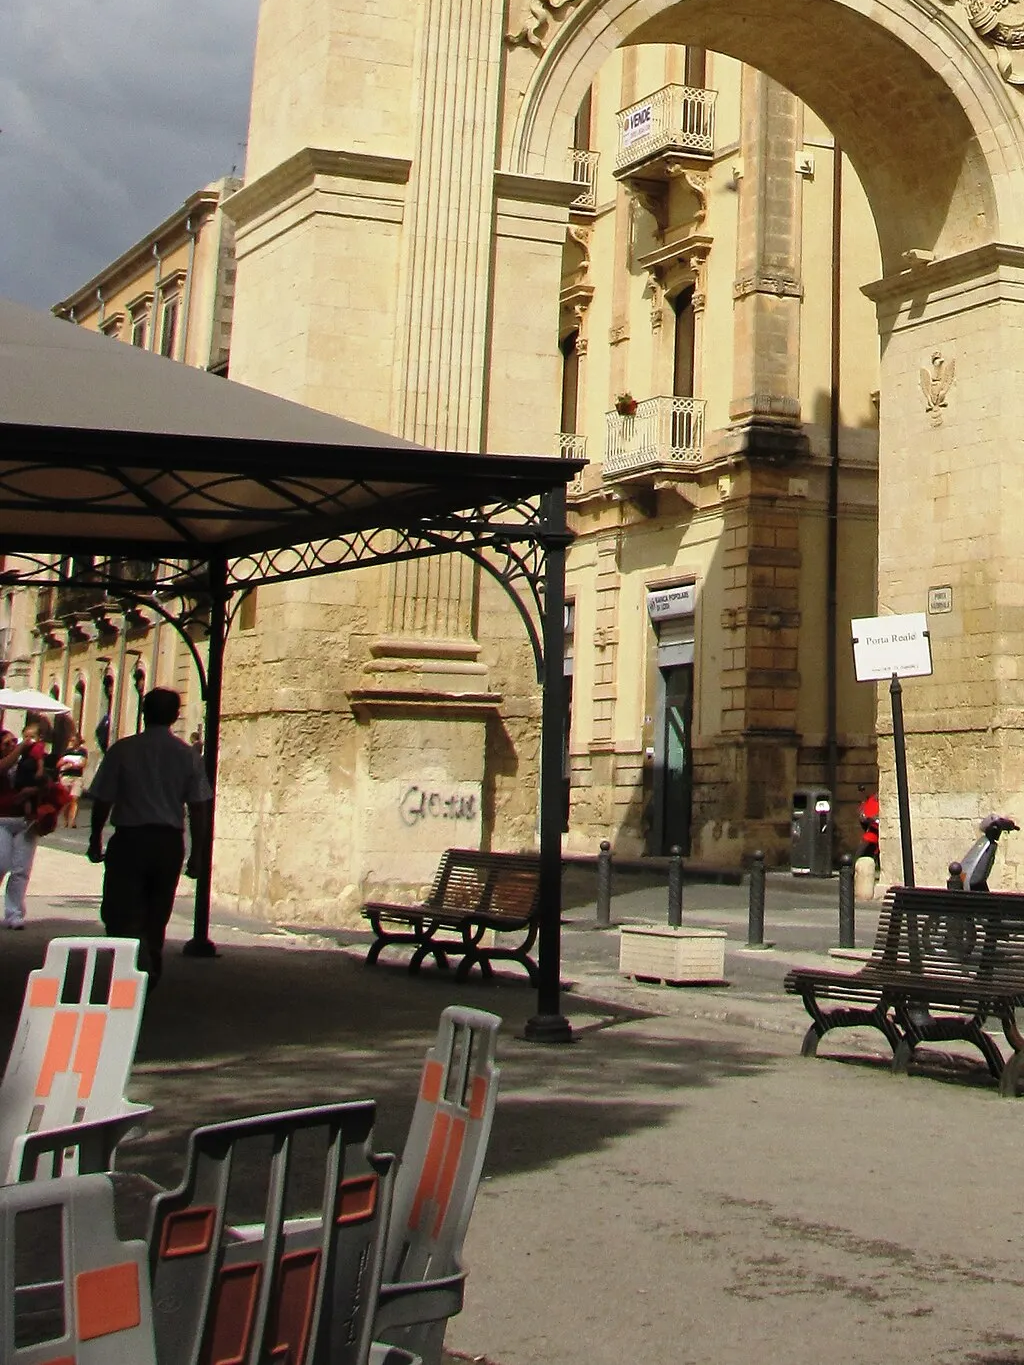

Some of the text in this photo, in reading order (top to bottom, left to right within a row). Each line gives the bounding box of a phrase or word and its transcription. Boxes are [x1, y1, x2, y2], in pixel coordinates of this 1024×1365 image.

[630, 106, 651, 129] VENDE
[866, 632, 916, 645] Porta Reale
